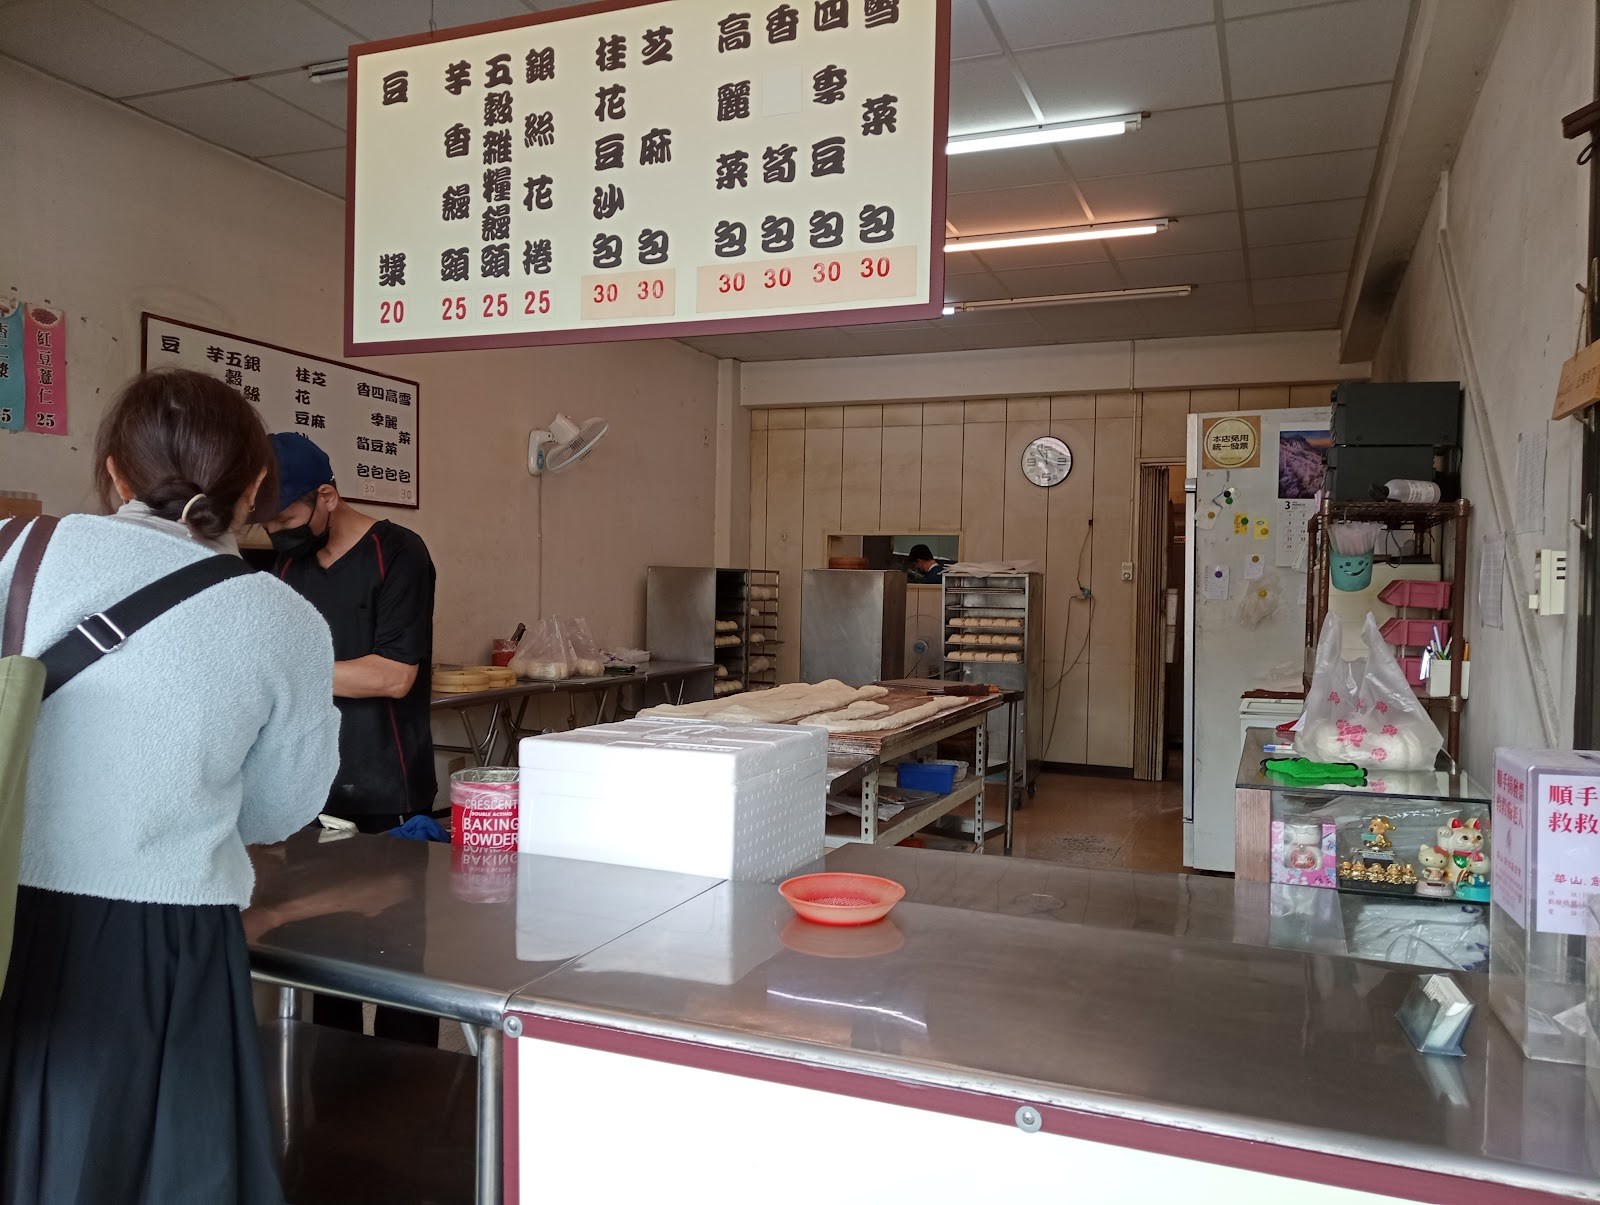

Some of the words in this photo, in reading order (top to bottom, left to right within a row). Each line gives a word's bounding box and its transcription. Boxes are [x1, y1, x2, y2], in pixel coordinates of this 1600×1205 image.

[638, 26, 674, 265] 芝麻包
[715, 13, 752, 258] 高麗菜包
[593, 36, 627, 269] 桂花豆沙包
[441, 60, 472, 282] 芋香饅頭
[481, 54, 513, 279] 五穀雜糧饅頭
[763, 268, 792, 289] 30
[812, 263, 842, 284] 30
[860, 258, 891, 279] 30
[637, 280, 664, 300] 30
[718, 272, 746, 293] 30
[524, 290, 551, 315] 25
[593, 284, 618, 305] 30
[380, 300, 404, 323] 20
[441, 297, 467, 320] 25
[482, 294, 508, 318] 25
[161, 335, 180, 354] 豆
[36, 412, 55, 427] 25
[1285, 500, 1291, 510] 3
[465, 799, 517, 810] CRESCENT
[463, 818, 518, 831] BAKING
[463, 832, 518, 846] POWDER
